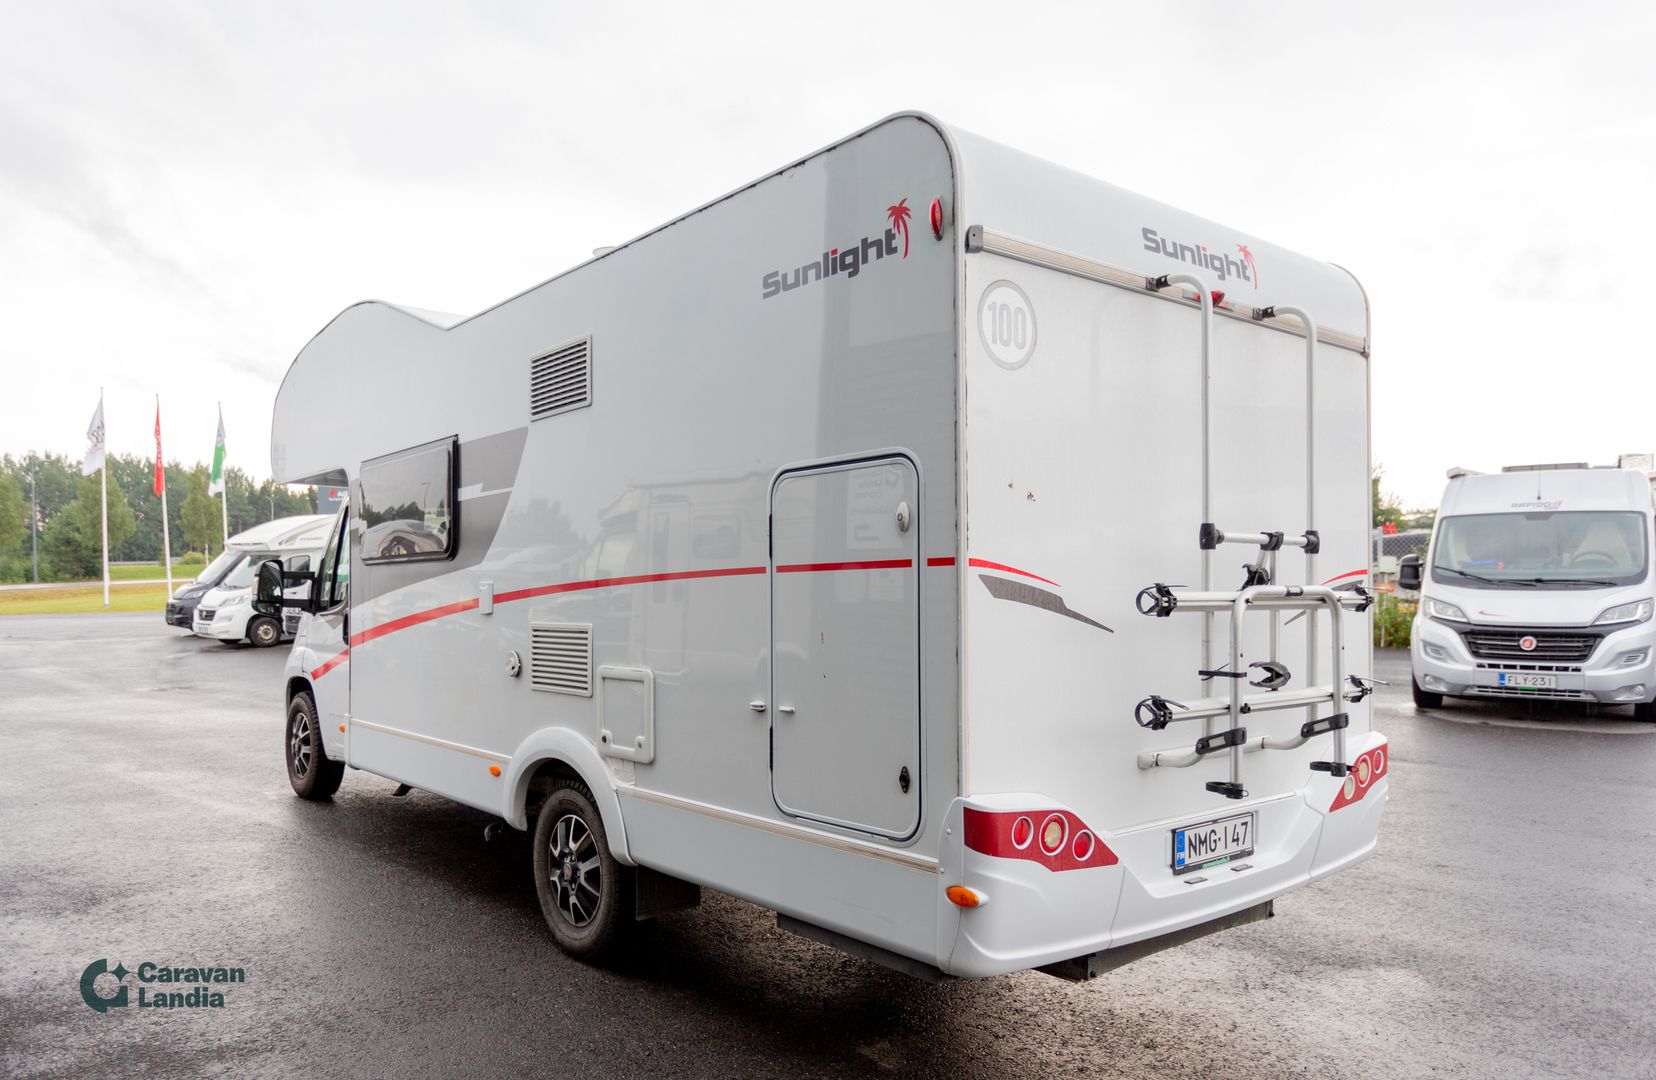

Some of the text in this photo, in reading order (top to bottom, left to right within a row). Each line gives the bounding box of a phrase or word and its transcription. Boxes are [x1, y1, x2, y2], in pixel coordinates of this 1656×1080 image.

[762, 227, 898, 300] Sunlight
[1141, 227, 1251, 282] Sunlight
[987, 301, 1027, 350] 100
[1507, 675, 1552, 686] FLY-231
[1188, 821, 1249, 859] NMG-147
